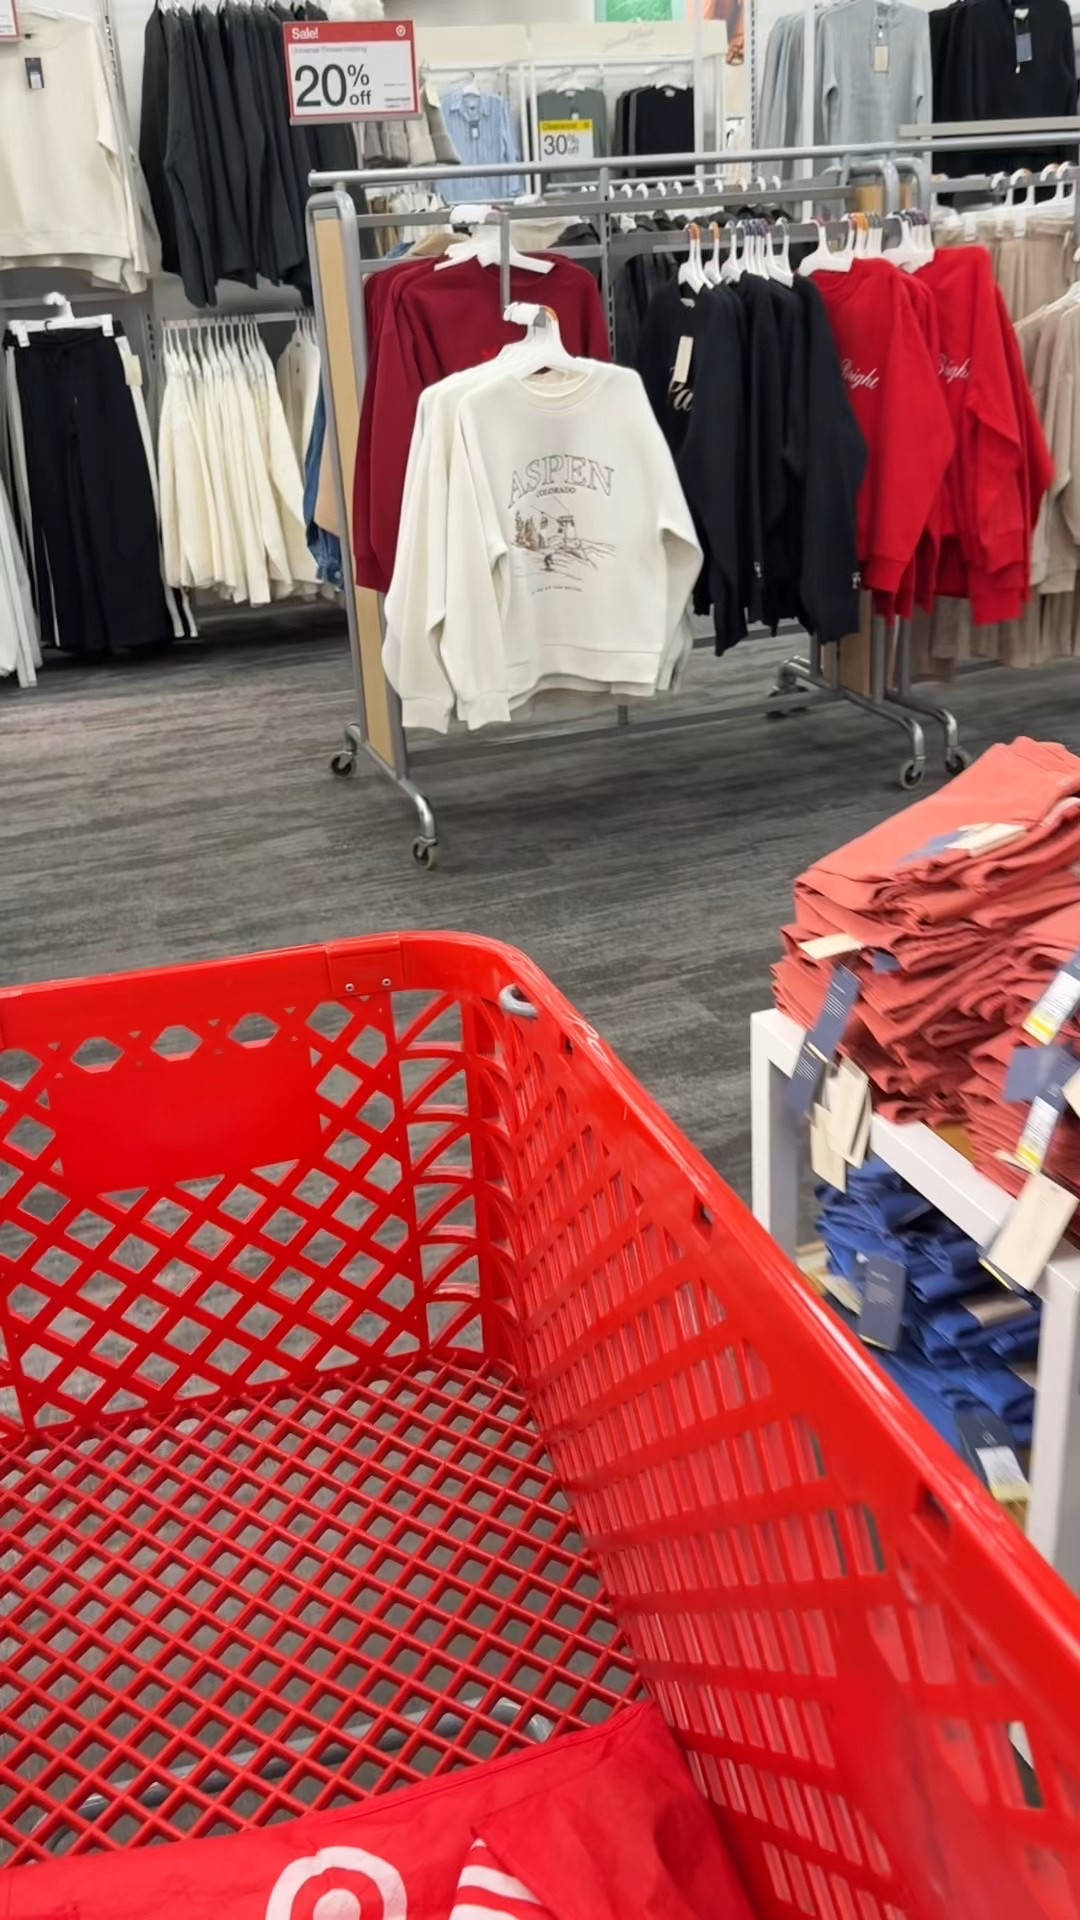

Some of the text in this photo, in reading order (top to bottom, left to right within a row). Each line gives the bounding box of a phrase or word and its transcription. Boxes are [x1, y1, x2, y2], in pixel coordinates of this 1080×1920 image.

[291, 27, 319, 40] Sale!
[294, 63, 371, 107] 20% off
[508, 454, 615, 509] ASPEN
